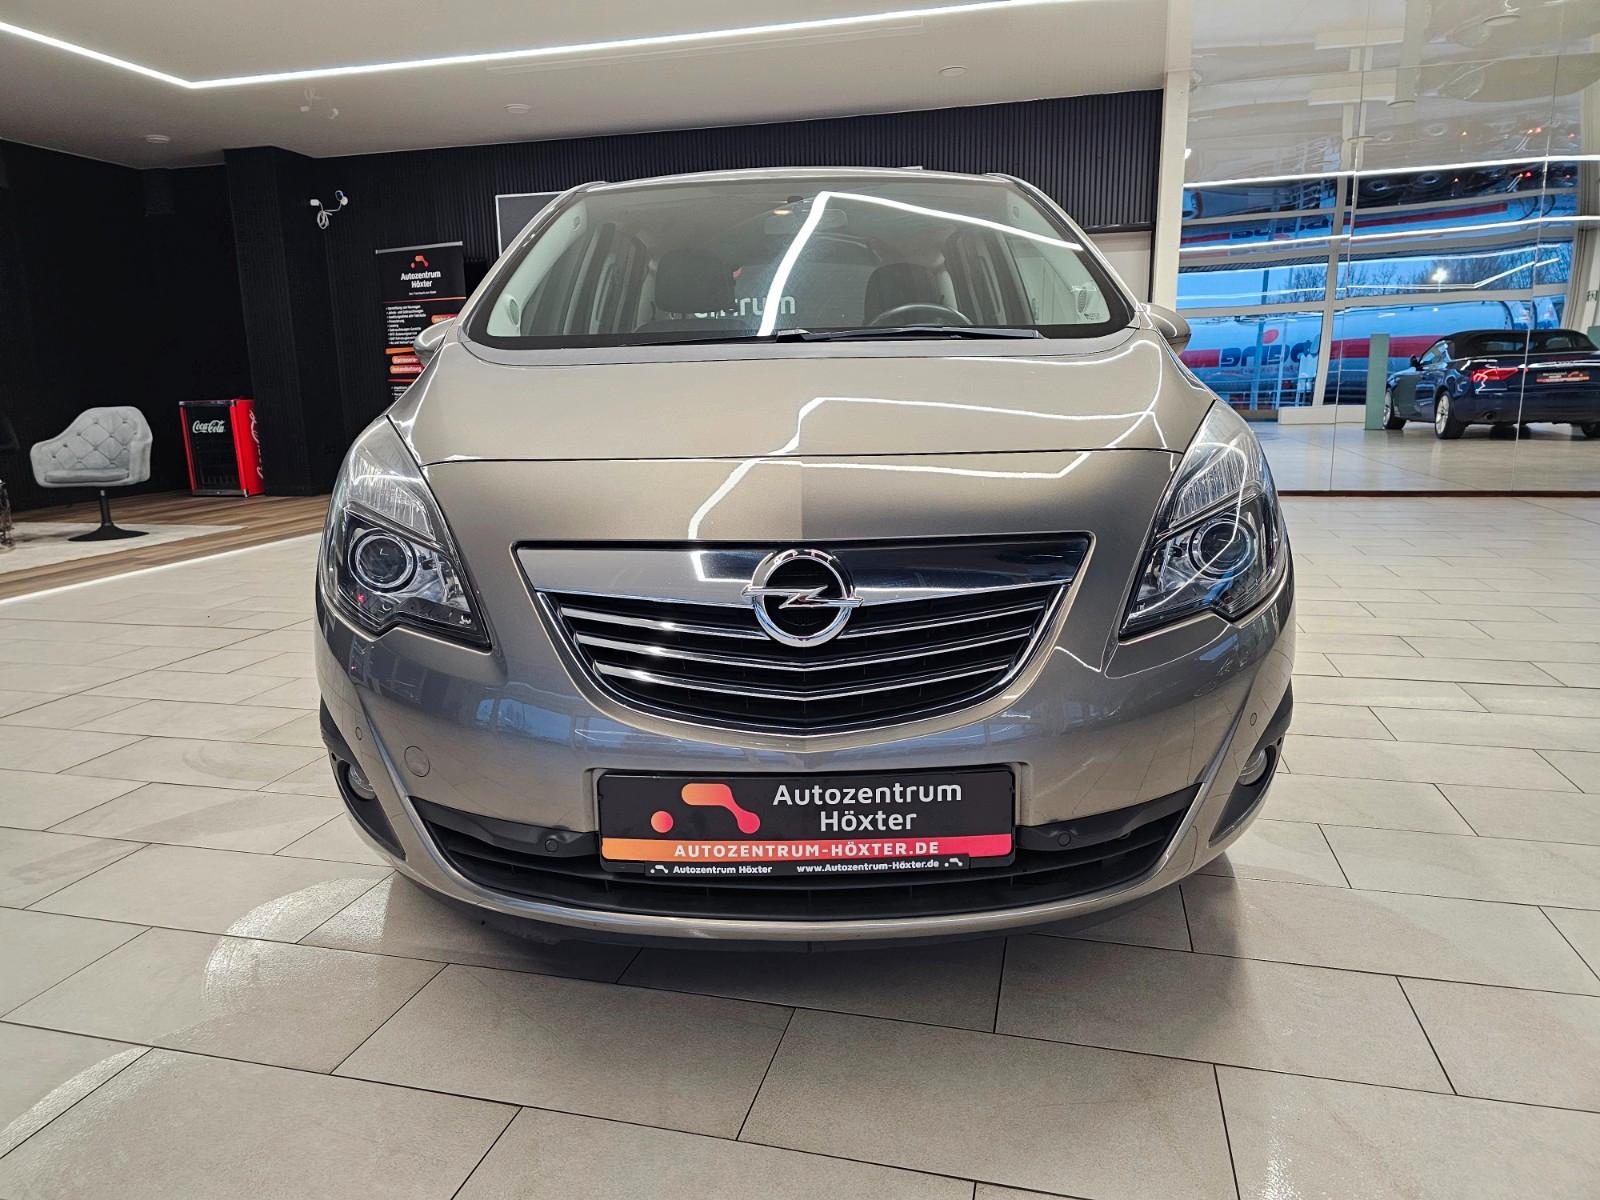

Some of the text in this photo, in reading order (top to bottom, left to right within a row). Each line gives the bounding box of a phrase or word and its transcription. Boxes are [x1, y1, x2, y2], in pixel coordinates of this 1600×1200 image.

[401, 270, 441, 280] Autozentrum
[411, 280, 432, 288] Höxter
[773, 783, 962, 806] Autozentrum
[820, 810, 917, 832] Höxter
[674, 841, 940, 858] AUTOZENTRUM-HÖXTER.DE
[673, 865, 773, 874] Autozentrum Höxter
[797, 859, 939, 873] www.Autozentrum-Höxter.de
